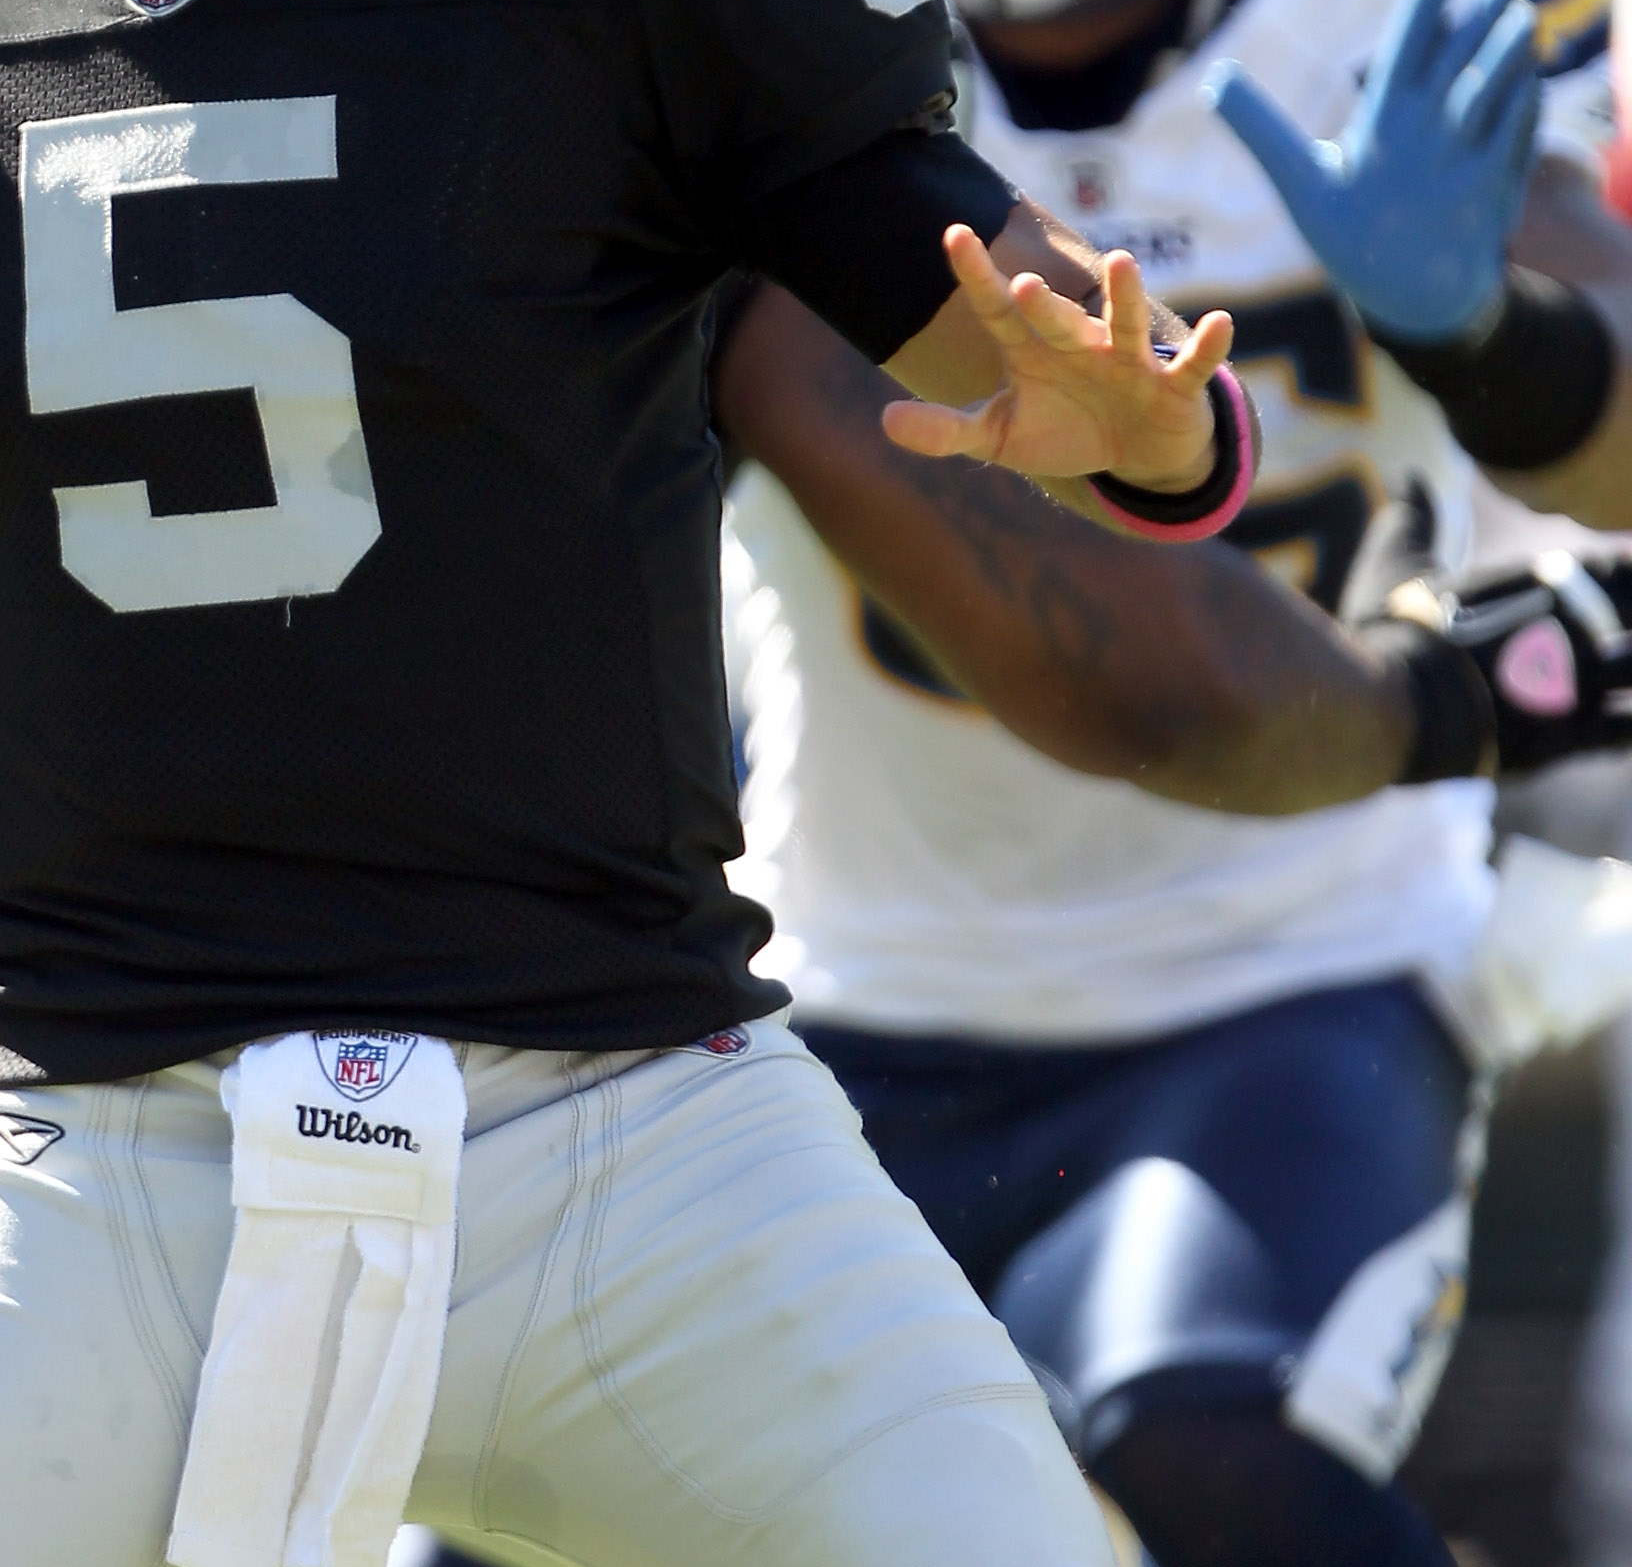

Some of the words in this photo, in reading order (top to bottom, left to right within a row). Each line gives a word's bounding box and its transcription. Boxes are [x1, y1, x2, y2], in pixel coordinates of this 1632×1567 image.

[20, 95, 382, 613] 5
[338, 1059, 380, 1086] NFL
[296, 1104, 412, 1152] Wilson
